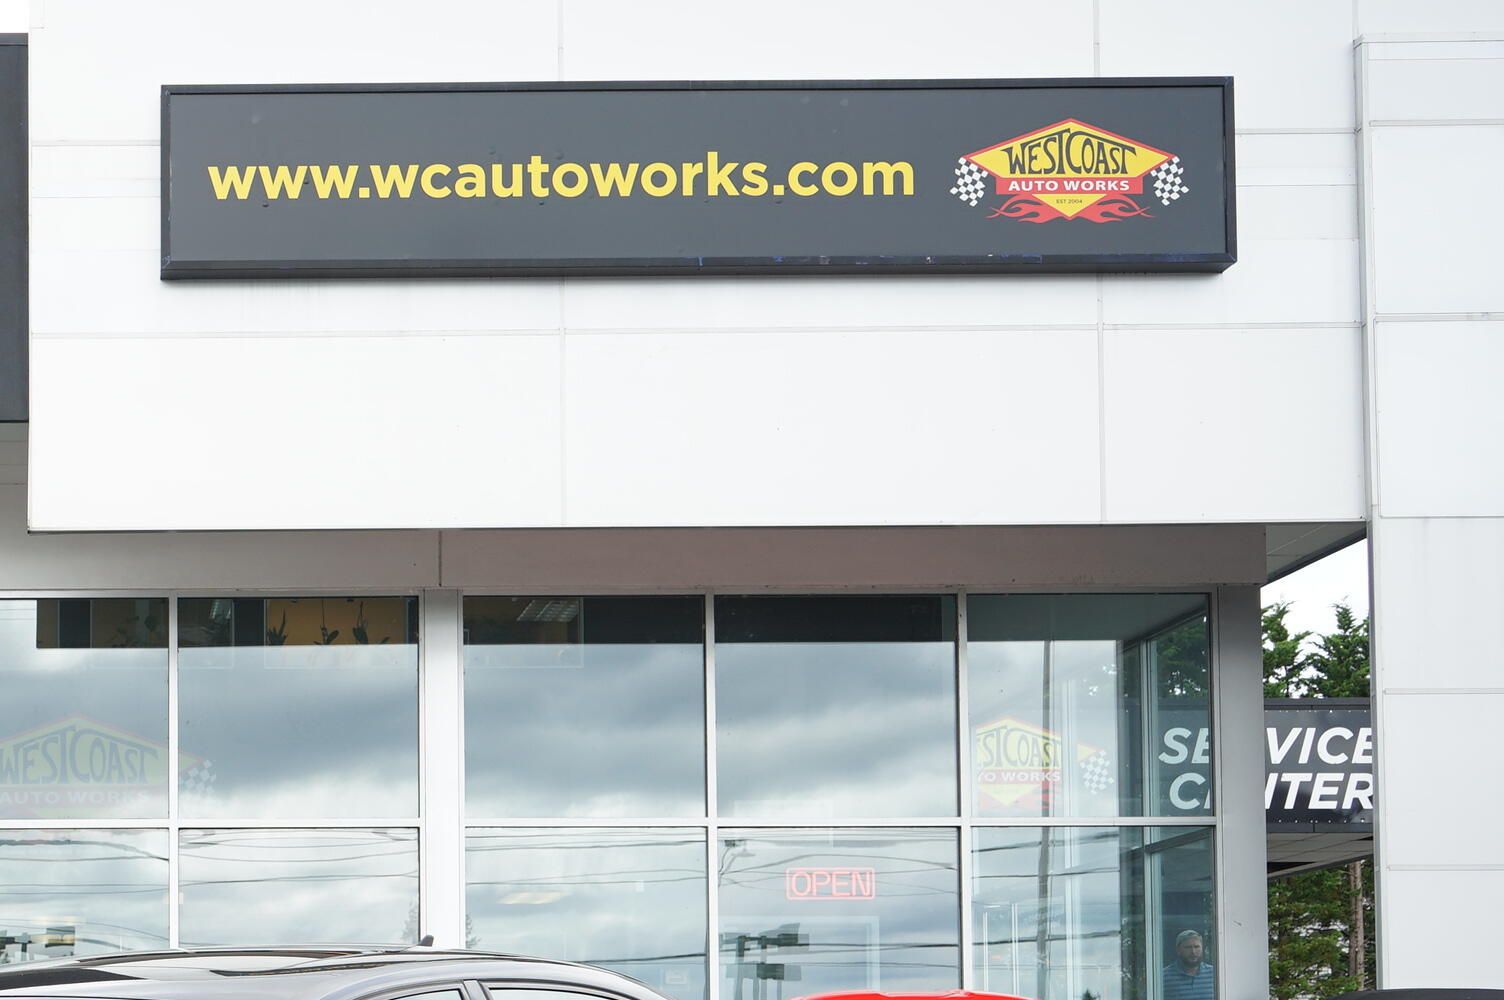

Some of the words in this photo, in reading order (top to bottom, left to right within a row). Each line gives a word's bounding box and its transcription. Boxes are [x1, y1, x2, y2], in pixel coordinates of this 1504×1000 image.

[208, 151, 915, 200] www.wcautoworks.com
[1008, 180, 1058, 191] AUTO
[1063, 180, 1130, 191] WORKS
[0, 791, 55, 805] AUTO
[791, 871, 872, 896] OPEN
